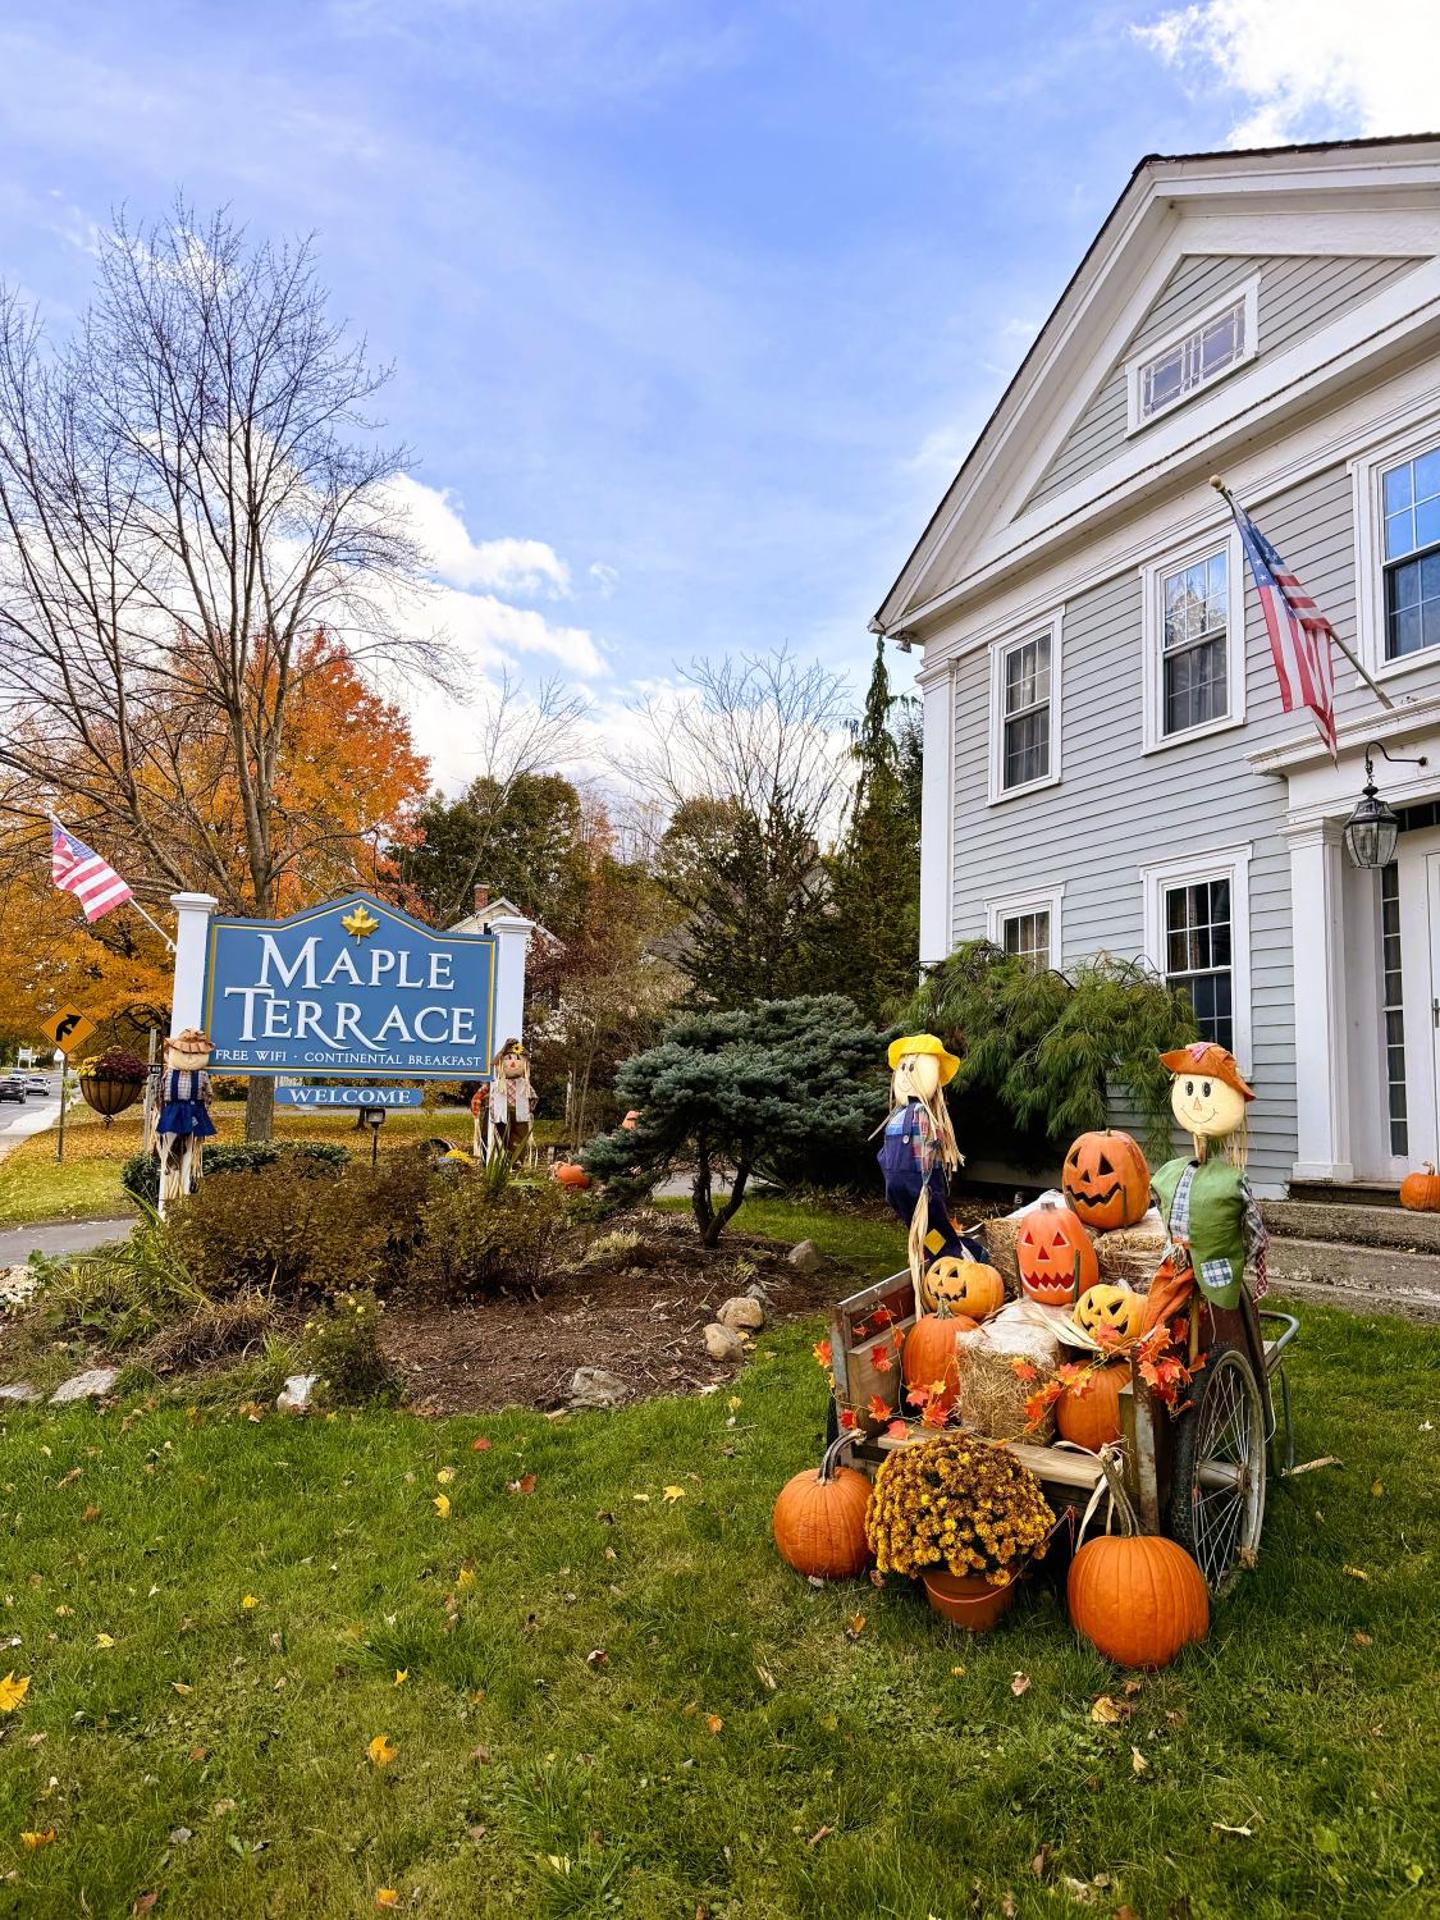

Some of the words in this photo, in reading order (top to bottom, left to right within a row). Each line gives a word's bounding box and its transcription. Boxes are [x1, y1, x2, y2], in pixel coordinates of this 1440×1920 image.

[254, 934, 455, 990] MAPLE
[224, 987, 477, 1051] TERRACE
[215, 1049, 249, 1060] FREE
[255, 1050, 287, 1062] WIFI
[304, 1052, 402, 1065] CONTINENTAL
[408, 1055, 482, 1066] BREAKFAST
[288, 1088, 412, 1104] WELCOME
